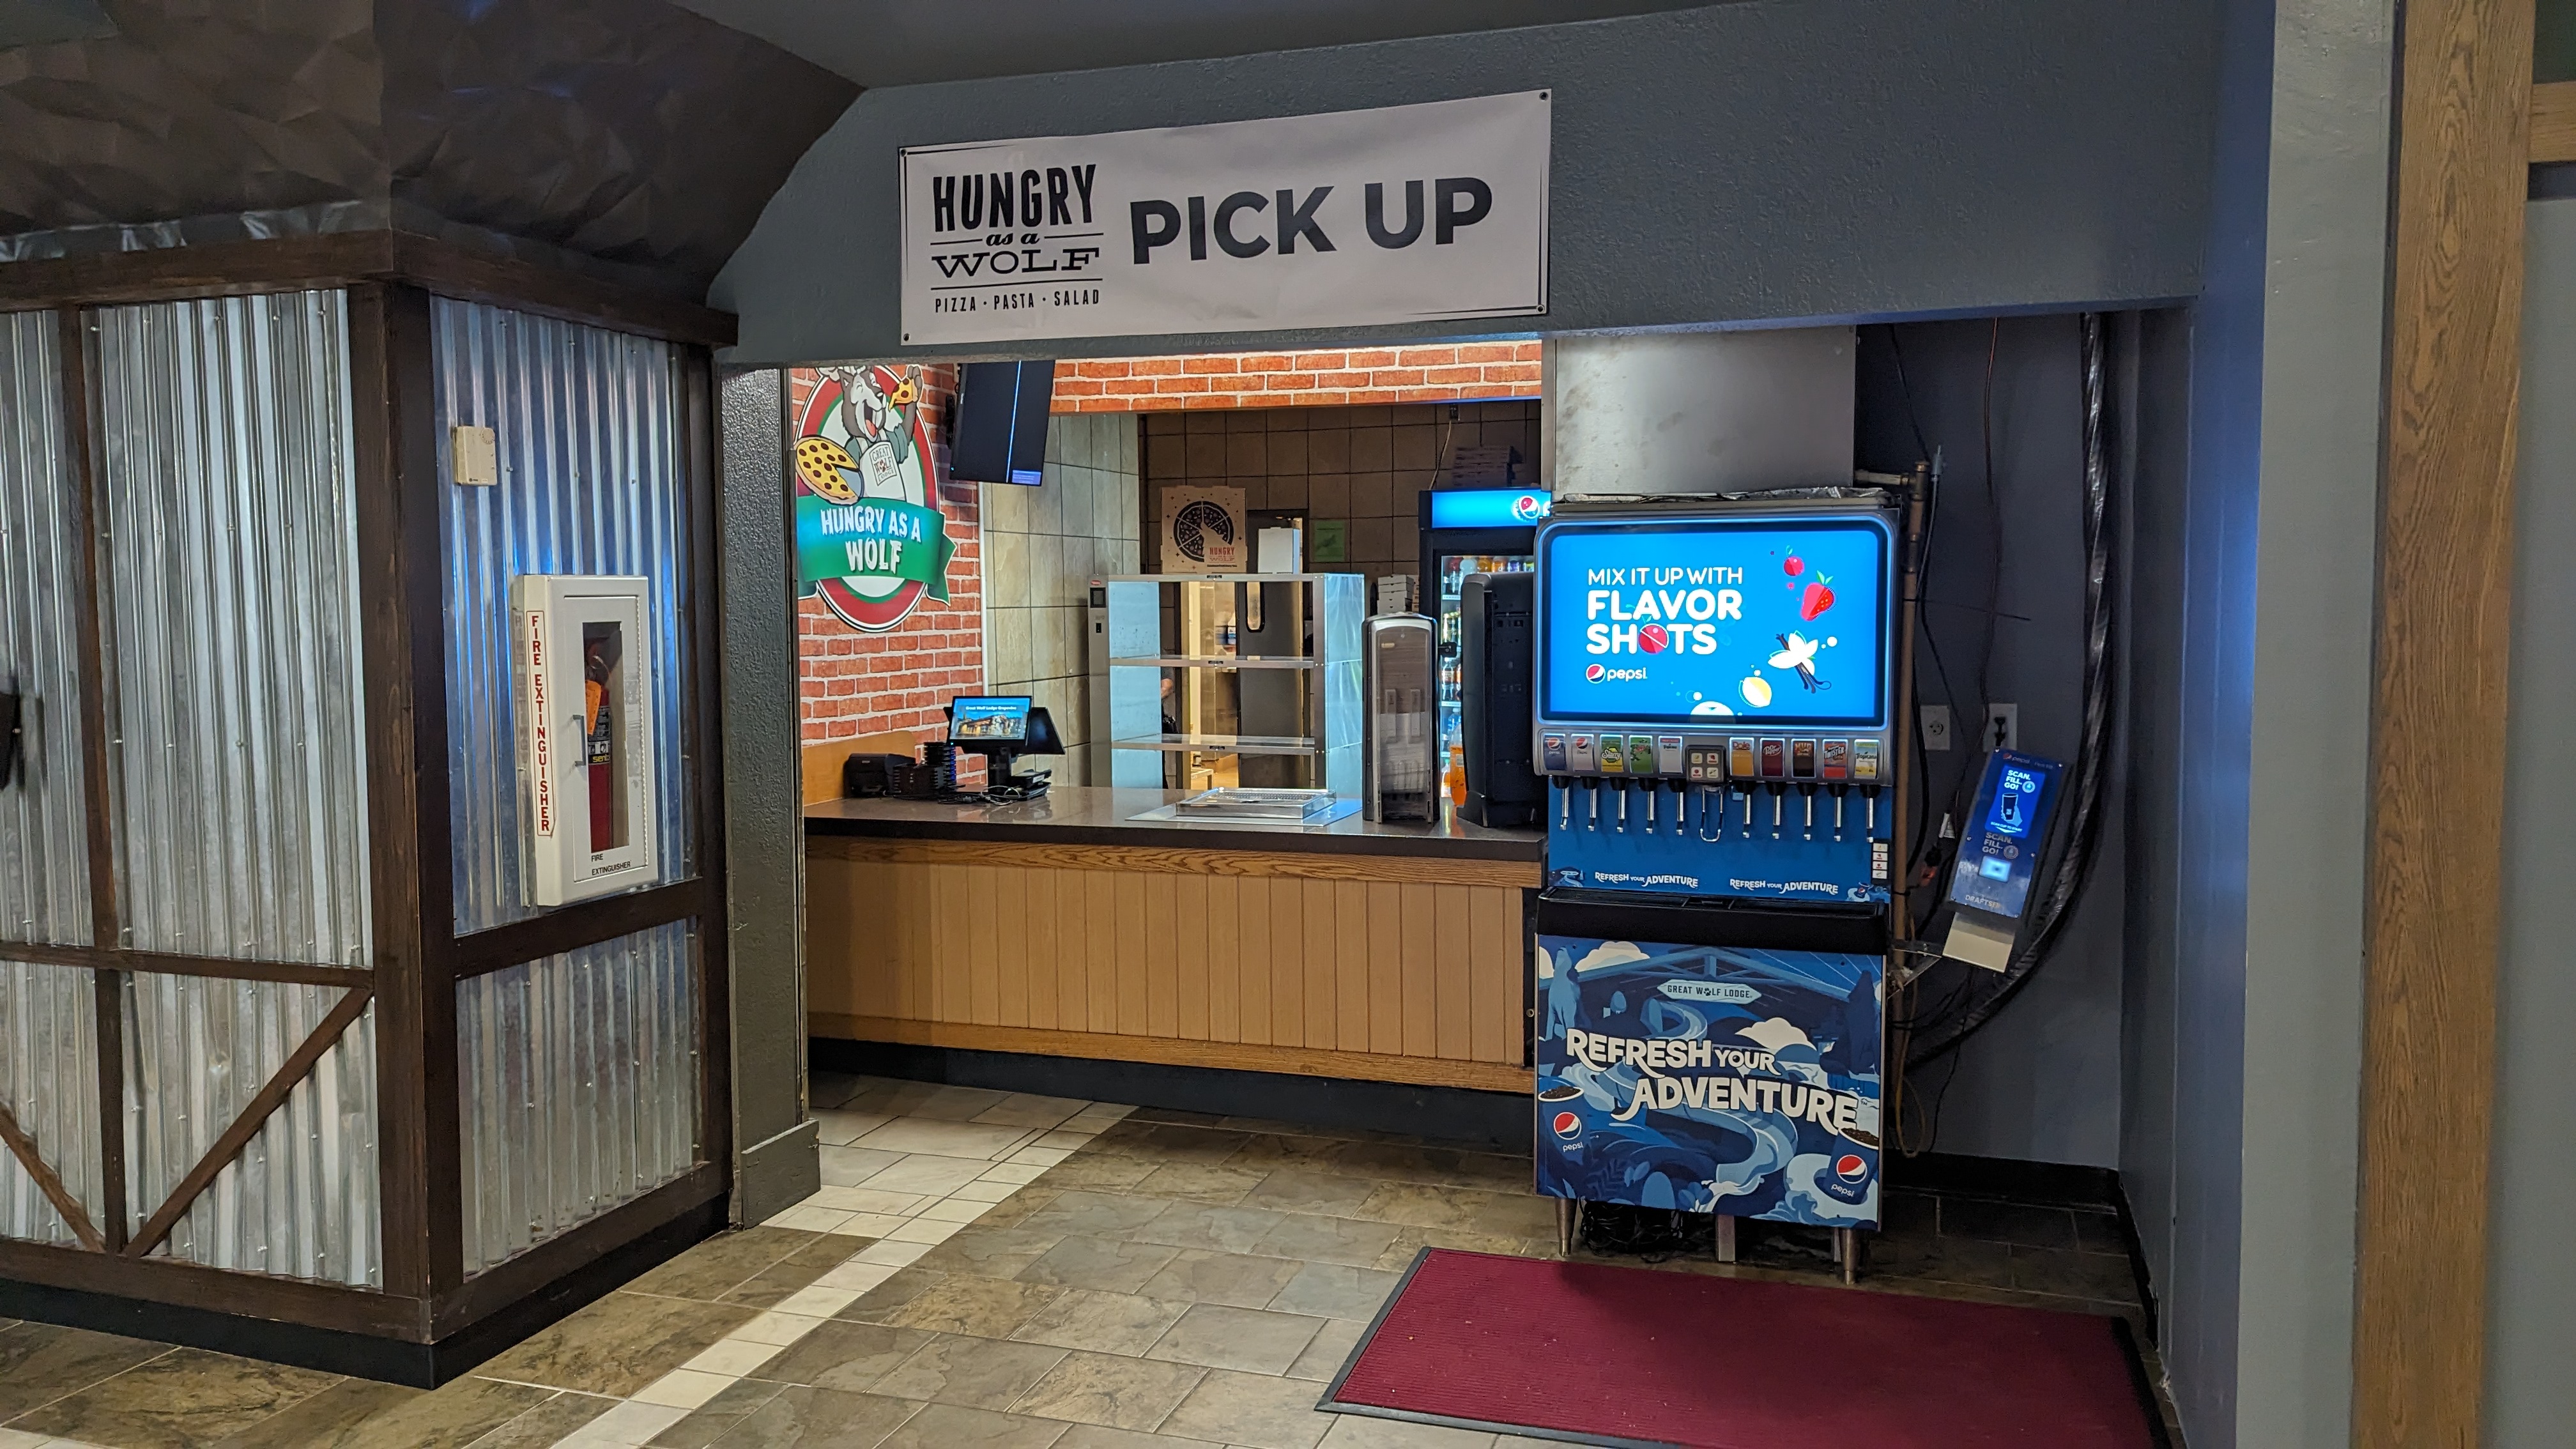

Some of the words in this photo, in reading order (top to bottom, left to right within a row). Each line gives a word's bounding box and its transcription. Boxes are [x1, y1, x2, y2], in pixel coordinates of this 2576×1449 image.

[933, 164, 1096, 232] HUNGRY
[1130, 185, 1338, 265] PICK
[1363, 176, 1492, 249] UP
[986, 233, 1013, 246] as
[1020, 233, 1040, 244] a
[931, 247, 1100, 278] WOLF
[935, 296, 976, 312] PIZZA
[993, 293, 1034, 310] PASTA
[1054, 289, 1100, 306] SALAD
[872, 447, 889, 461] GREAT
[878, 469, 894, 482] LODGE
[820, 505, 884, 536] HUNGRY
[889, 510, 908, 538] AS
[911, 517, 921, 542] A
[845, 537, 902, 573] WOLF
[1588, 568, 1625, 585] MIX
[1631, 567, 1650, 585] IT
[1655, 568, 1683, 585] UP
[1687, 567, 1743, 585] WITH
[1587, 588, 1743, 620] FLAVOR
[532, 615, 541, 666] FIRE
[1607, 666, 1648, 682] pepsi
[1733, 741, 1750, 749] Dole
[1824, 746, 1844, 758] TWISTER
[535, 673, 550, 832] EXTINGUISHER
[1602, 749, 1621, 760] Starry
[2005, 776, 2022, 785] FILL.
[2007, 770, 2031, 780] SCAN.
[2004, 782, 2019, 790] GO!
[1984, 839, 2003, 849] FILL.
[1986, 832, 2012, 844] SCAN.
[1982, 846, 1998, 855] GO!
[592, 854, 603, 862] FIRE
[592, 861, 631, 875] EXTINGUISHER
[1595, 871, 1629, 884] REFRESH
[1641, 875, 1698, 888] ADVENTURE
[1730, 878, 1766, 891] REFRESH
[1779, 882, 1839, 895] ADVENTURE
[1667, 985, 1692, 994] GREAT
[1724, 989, 1750, 998] LODGE
[1567, 1028, 1712, 1078] REFRESH
[1714, 1047, 1782, 1075] YOUR
[1611, 1077, 1859, 1136] ADVENTURE
[1563, 1141, 1583, 1153] pepsi
[1831, 1183, 1855, 1197] pepsi
